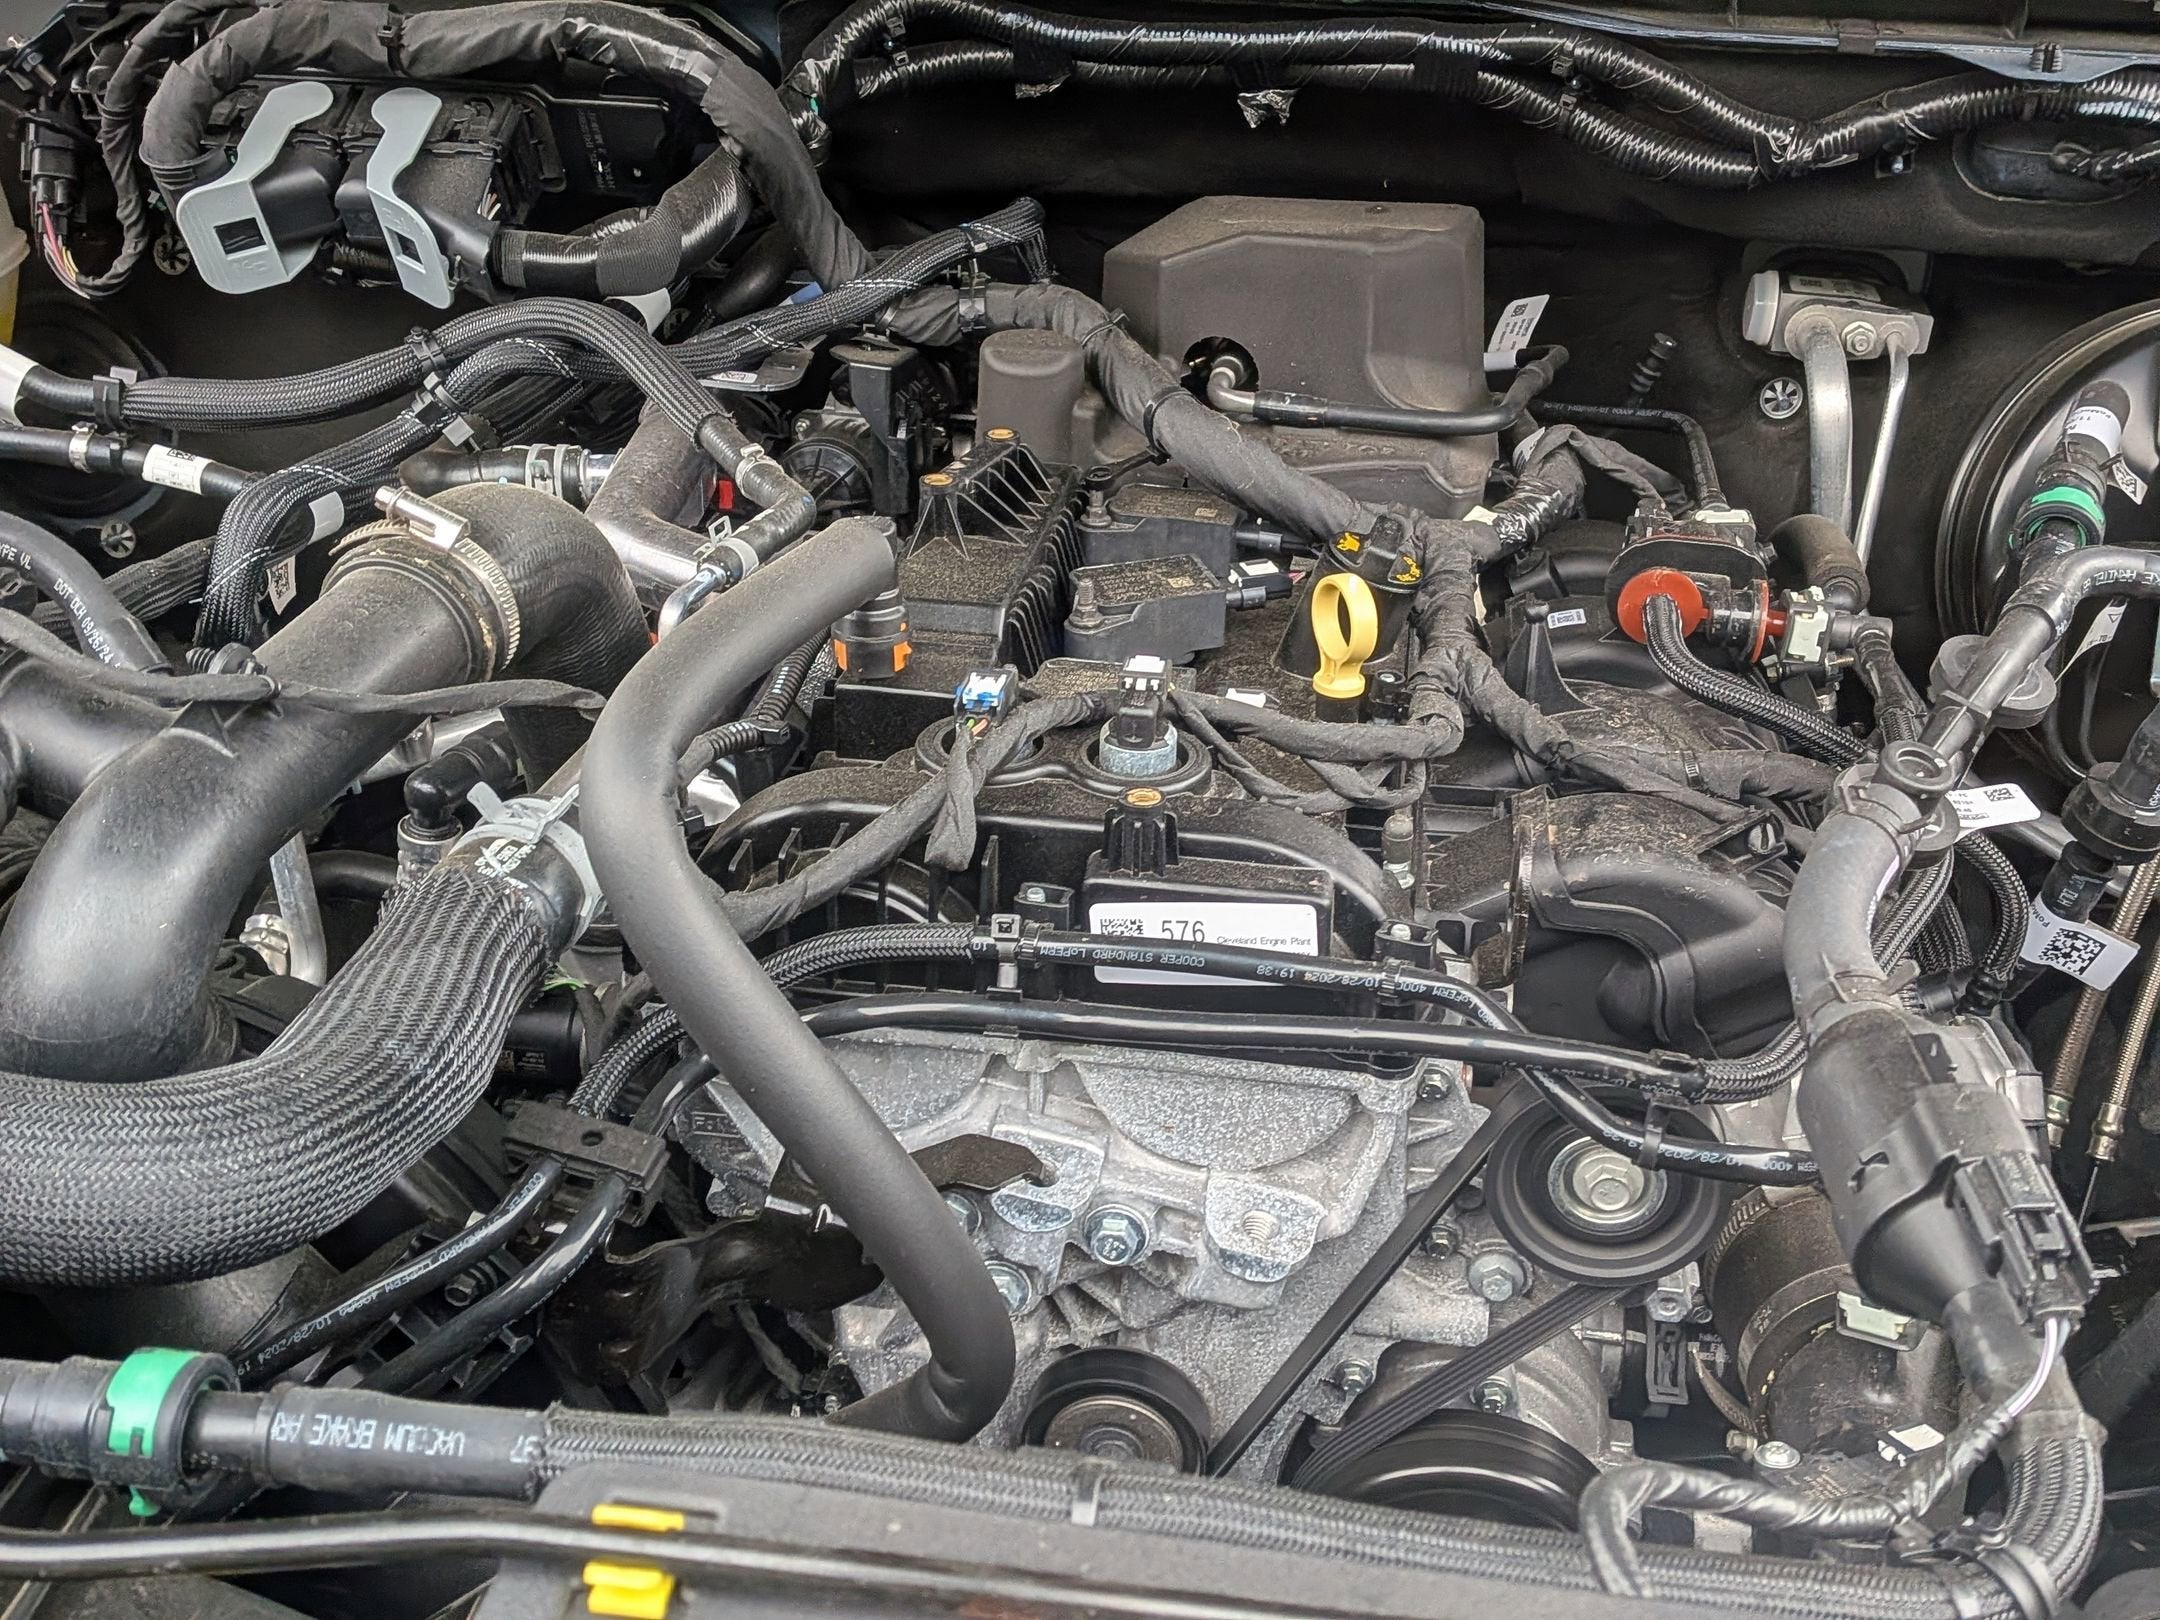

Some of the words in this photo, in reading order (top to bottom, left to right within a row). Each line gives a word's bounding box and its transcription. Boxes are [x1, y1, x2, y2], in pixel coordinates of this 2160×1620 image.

[53, 577, 73, 599] DOT
[1161, 919, 1206, 943] 576
[1260, 936, 1287, 947] Engine
[1290, 936, 1312, 946] Plant
[1092, 948, 1154, 963] STANDARD
[1160, 953, 1205, 968] COOPER
[1303, 972, 1380, 990] 10/28/2024
[308, 1413, 378, 1450] BRAKE
